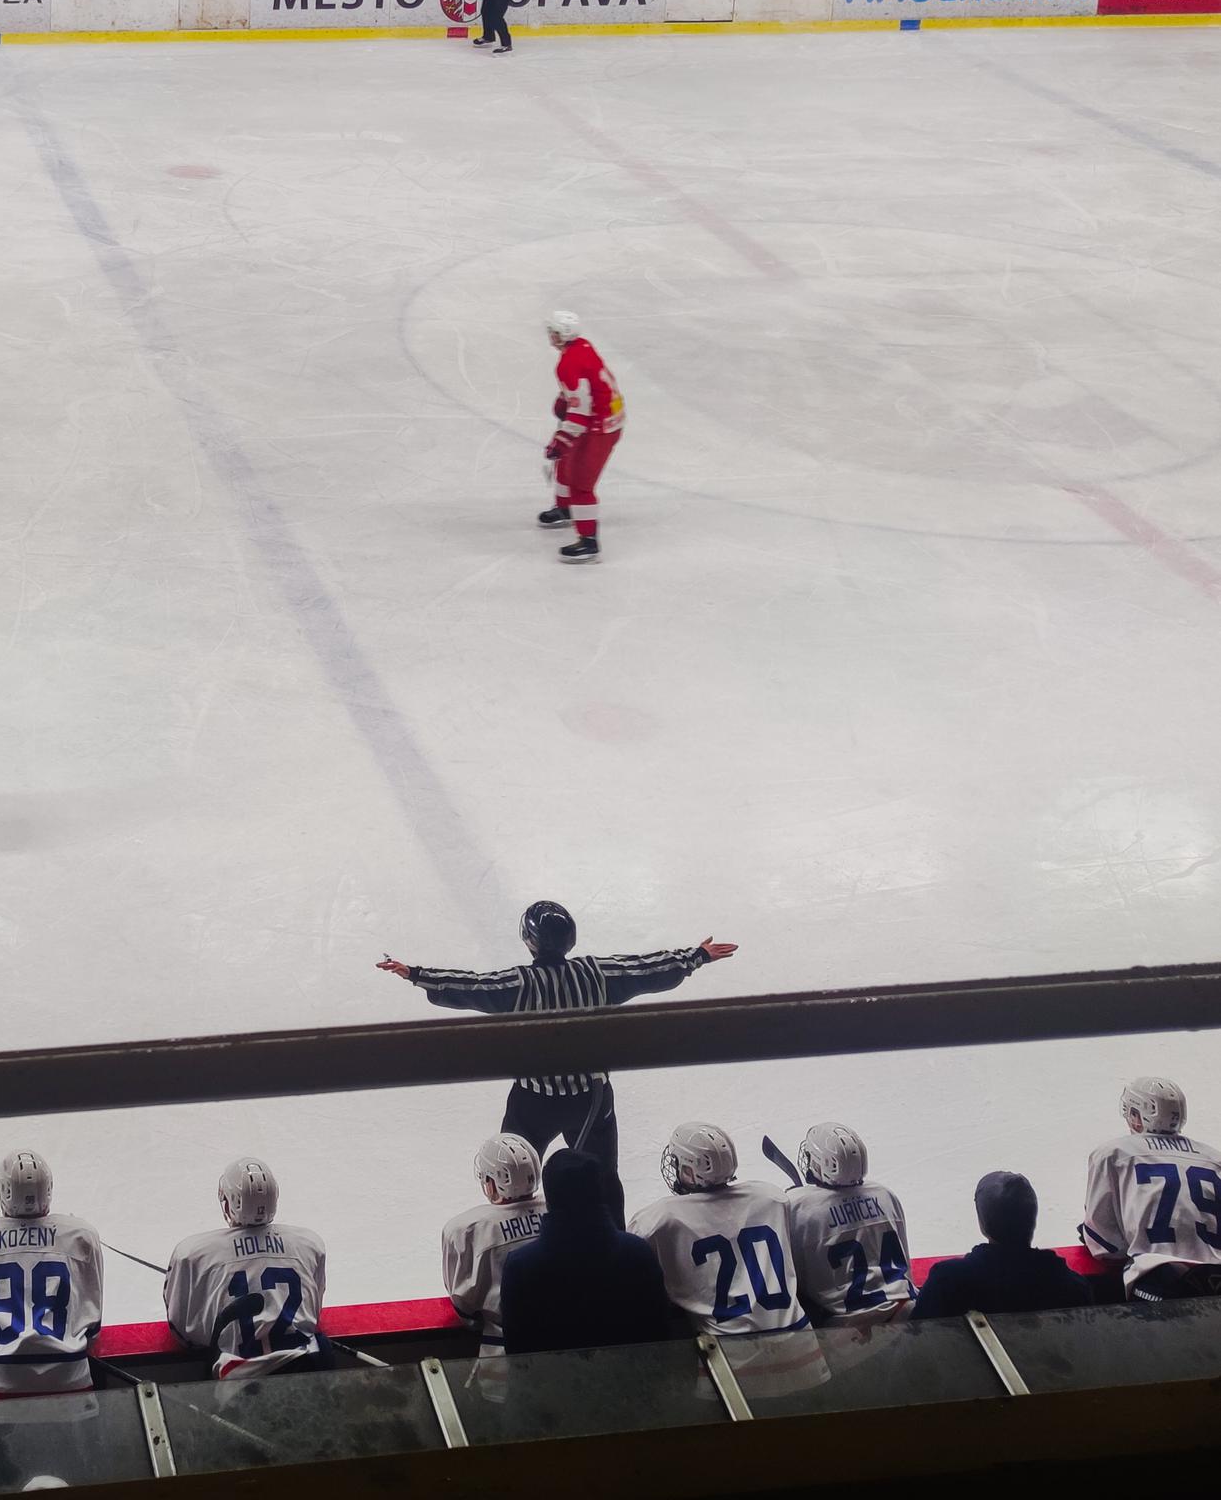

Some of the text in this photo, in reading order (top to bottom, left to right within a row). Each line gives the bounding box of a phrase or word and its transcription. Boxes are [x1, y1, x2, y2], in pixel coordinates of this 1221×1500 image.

[1135, 1162, 1221, 1250] 79
[0, 1222, 57, 1249] KOŽENÝ
[500, 1209, 547, 1242] HRUŠ
[234, 1231, 285, 1257] HOLÁŇ
[691, 1225, 791, 1324] 20
